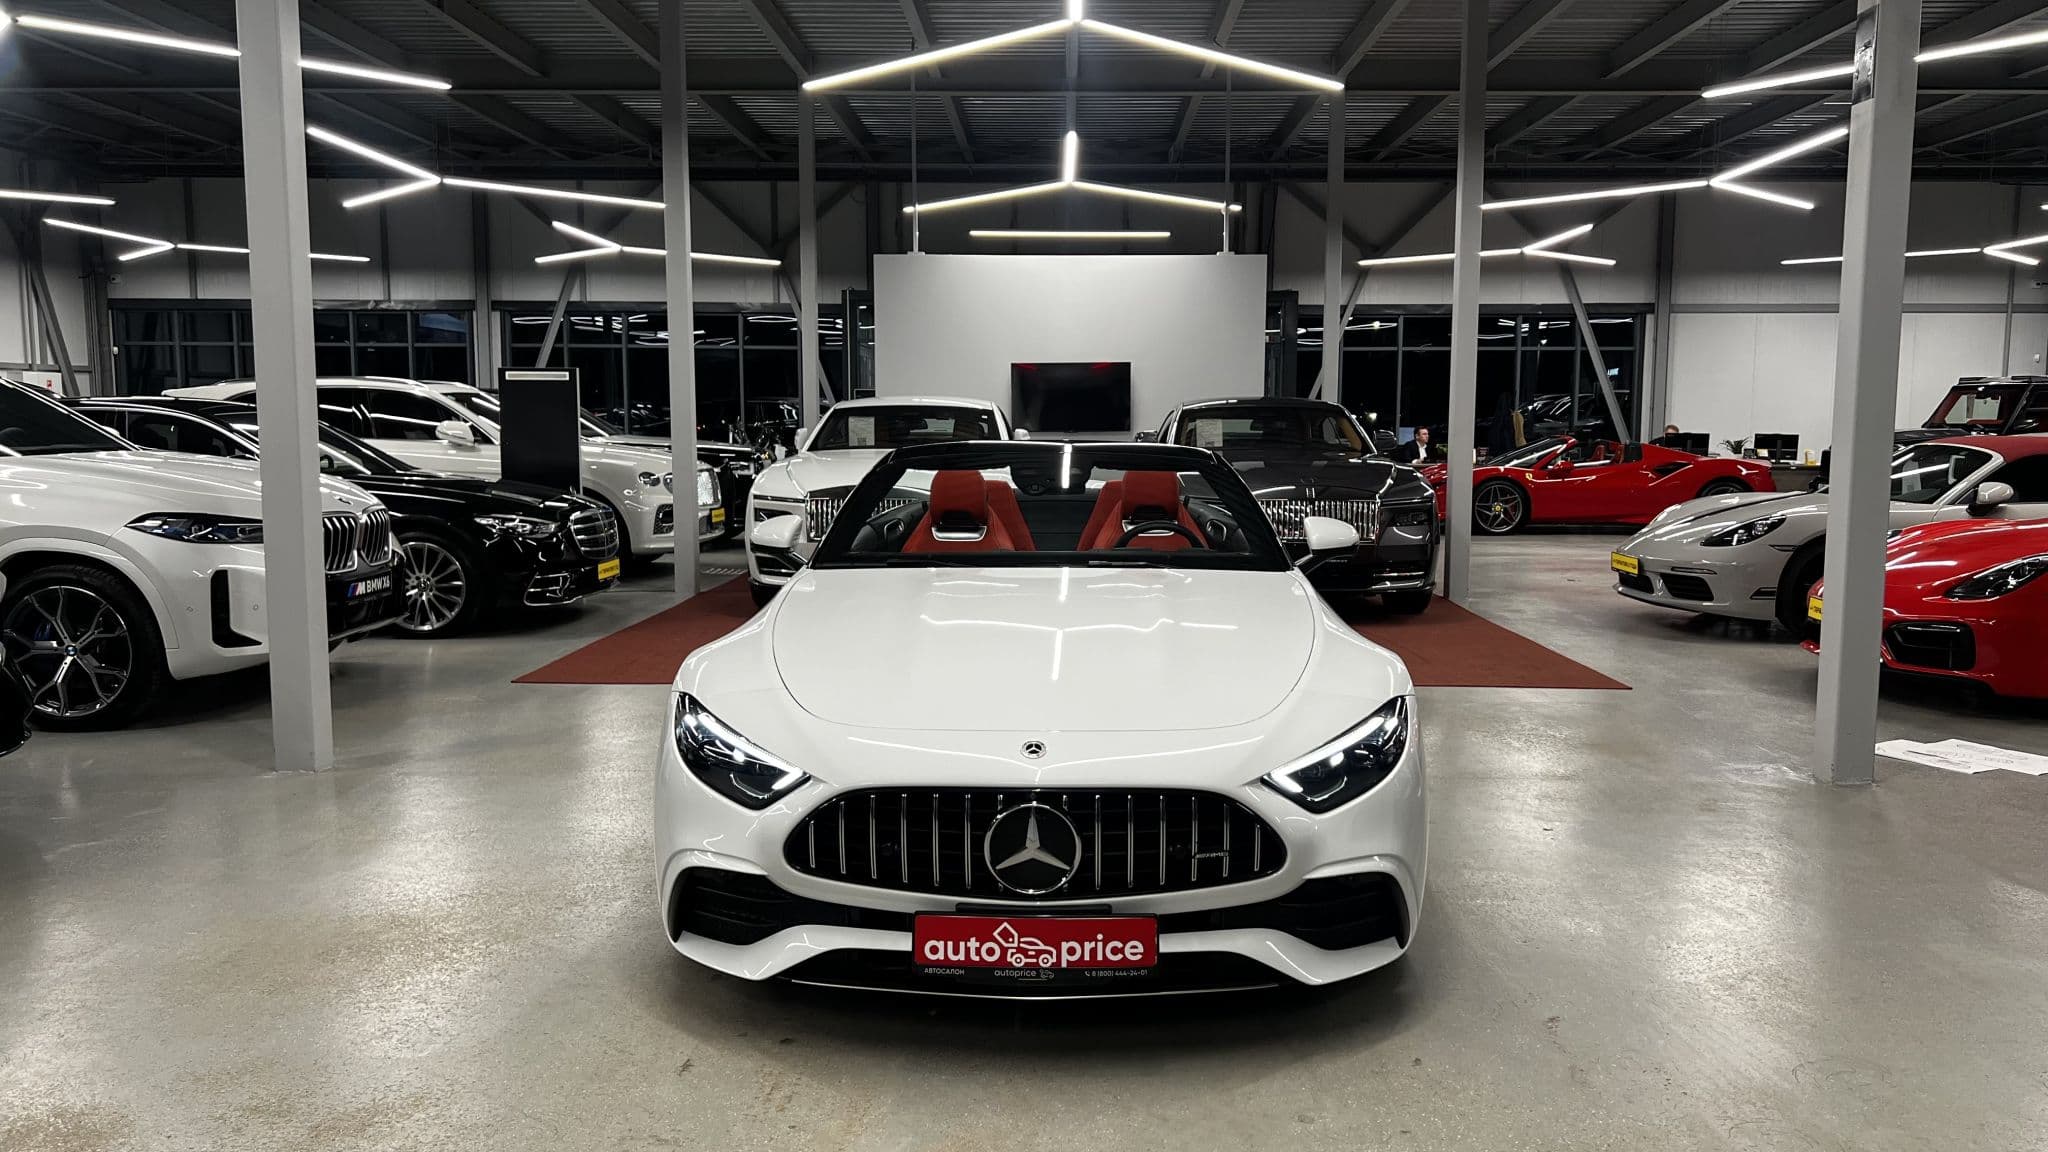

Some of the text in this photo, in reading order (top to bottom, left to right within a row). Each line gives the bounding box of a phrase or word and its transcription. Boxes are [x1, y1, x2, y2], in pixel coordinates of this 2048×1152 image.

[366, 577, 382, 593] BMW
[924, 933, 1144, 968] auto price
[924, 968, 965, 976] АВТОСАЛОН
[994, 968, 1037, 978] autoprice
